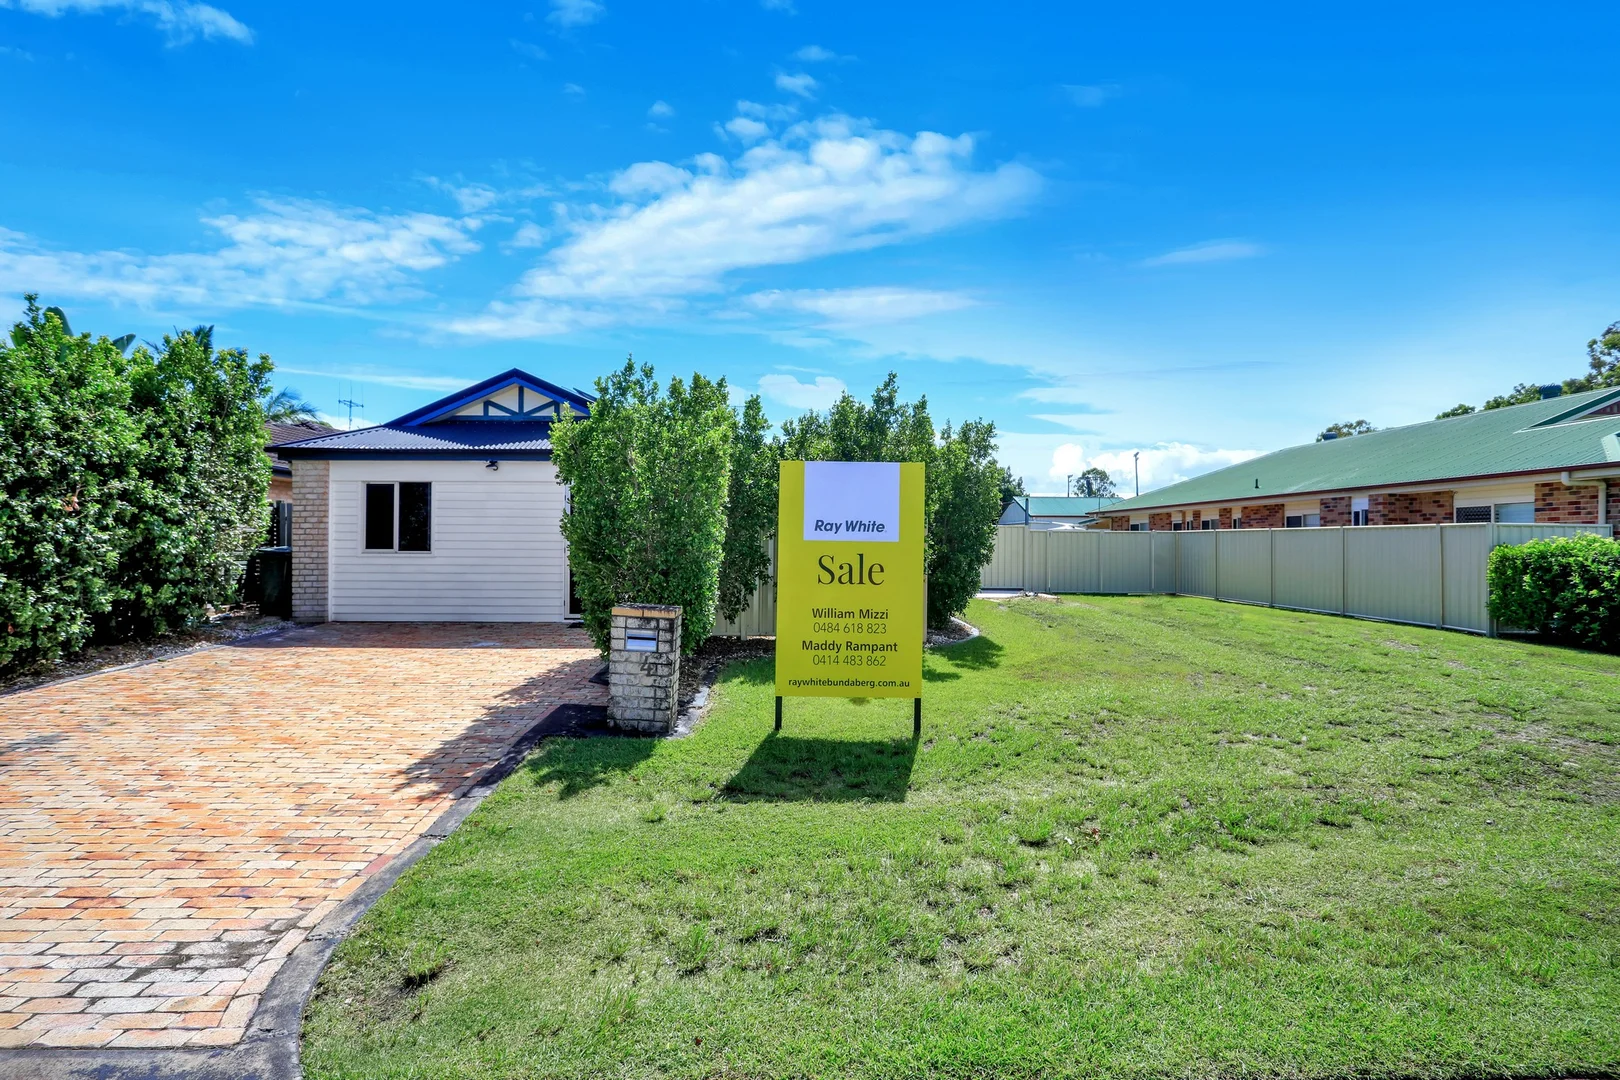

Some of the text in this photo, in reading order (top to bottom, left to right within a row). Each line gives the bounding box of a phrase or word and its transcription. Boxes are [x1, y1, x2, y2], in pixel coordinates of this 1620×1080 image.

[814, 520, 886, 534] Ray White
[817, 553, 885, 586] Sale
[812, 608, 889, 620] William Mizzi
[813, 622, 887, 634] 0484 618 823
[802, 640, 898, 654] Maddy Rampant
[640, 656, 654, 677] 4
[813, 654, 887, 667] 0414 483 862
[788, 677, 910, 688] raywhitebundaberg.com.au
